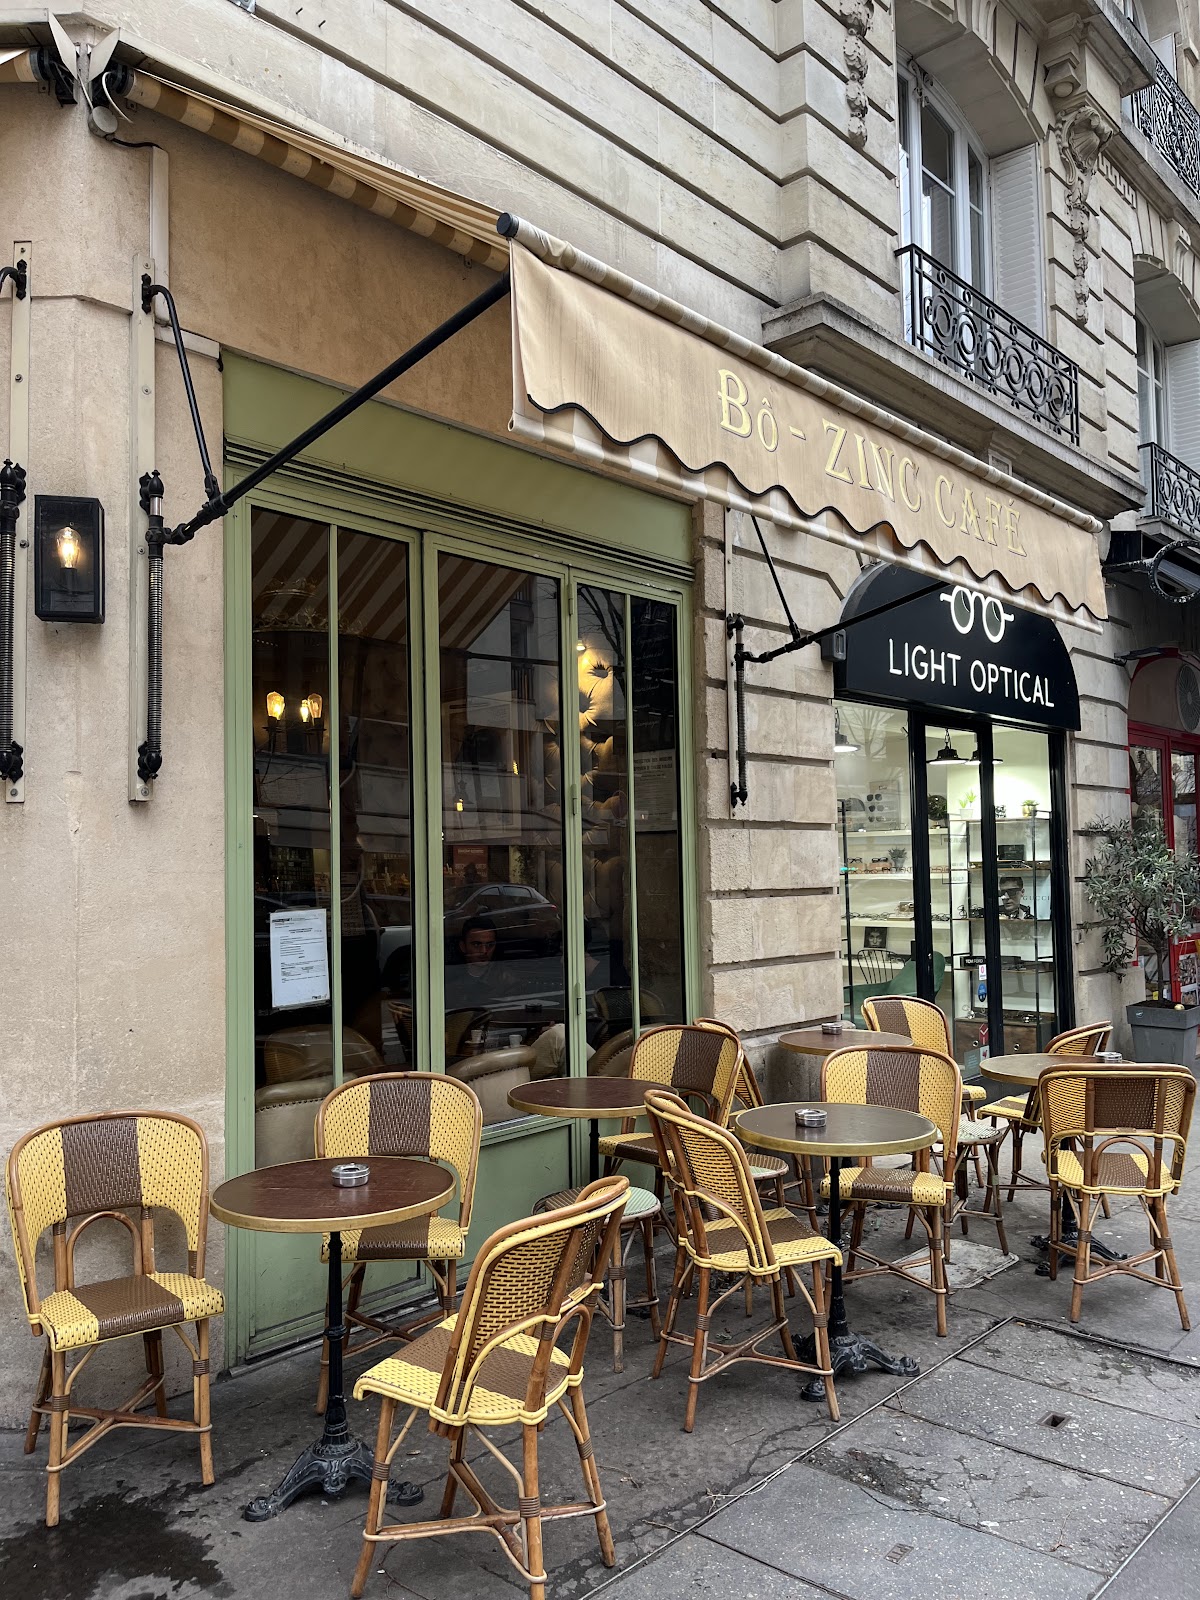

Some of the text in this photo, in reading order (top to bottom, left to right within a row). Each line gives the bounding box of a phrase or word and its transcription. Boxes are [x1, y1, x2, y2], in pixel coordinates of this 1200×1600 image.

[822, 418, 922, 512] ZINC
[934, 474, 1028, 558] CAFÉ
[888, 638, 1055, 708] LIGHT OPTICAL
